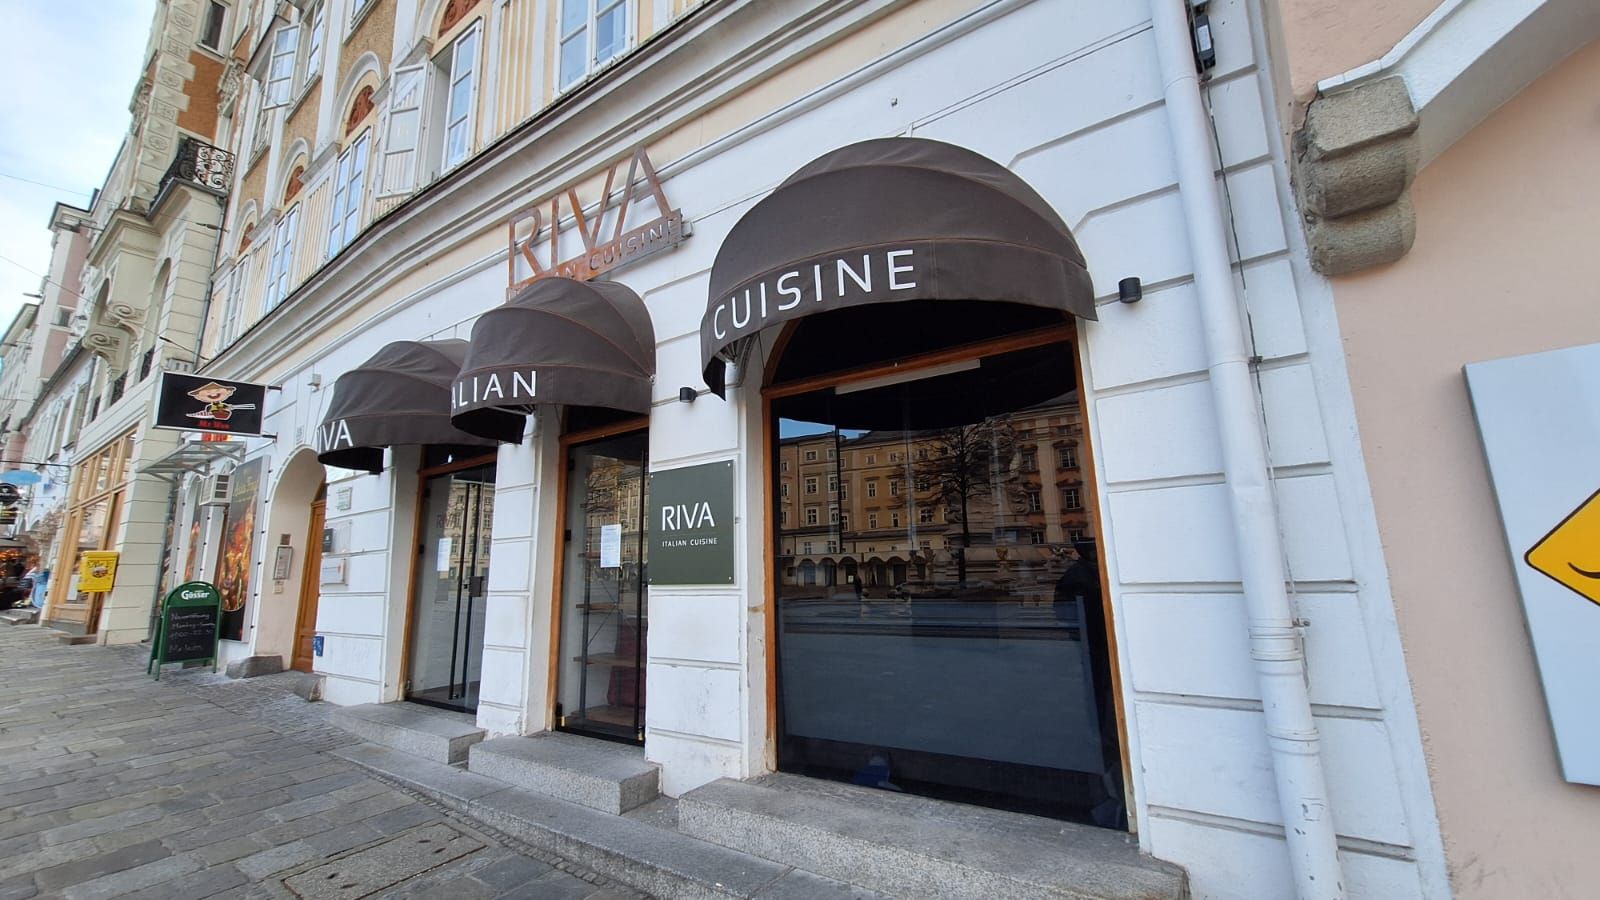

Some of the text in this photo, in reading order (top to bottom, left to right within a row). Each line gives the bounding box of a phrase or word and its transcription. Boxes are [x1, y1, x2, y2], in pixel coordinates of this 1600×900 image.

[508, 146, 672, 287] RIVA
[589, 219, 680, 271] CUISINE
[714, 249, 918, 340] CUISINE
[316, 419, 353, 454] IVA
[661, 501, 715, 531] RIVA
[662, 537, 718, 548] ITALIAN CUISINE
